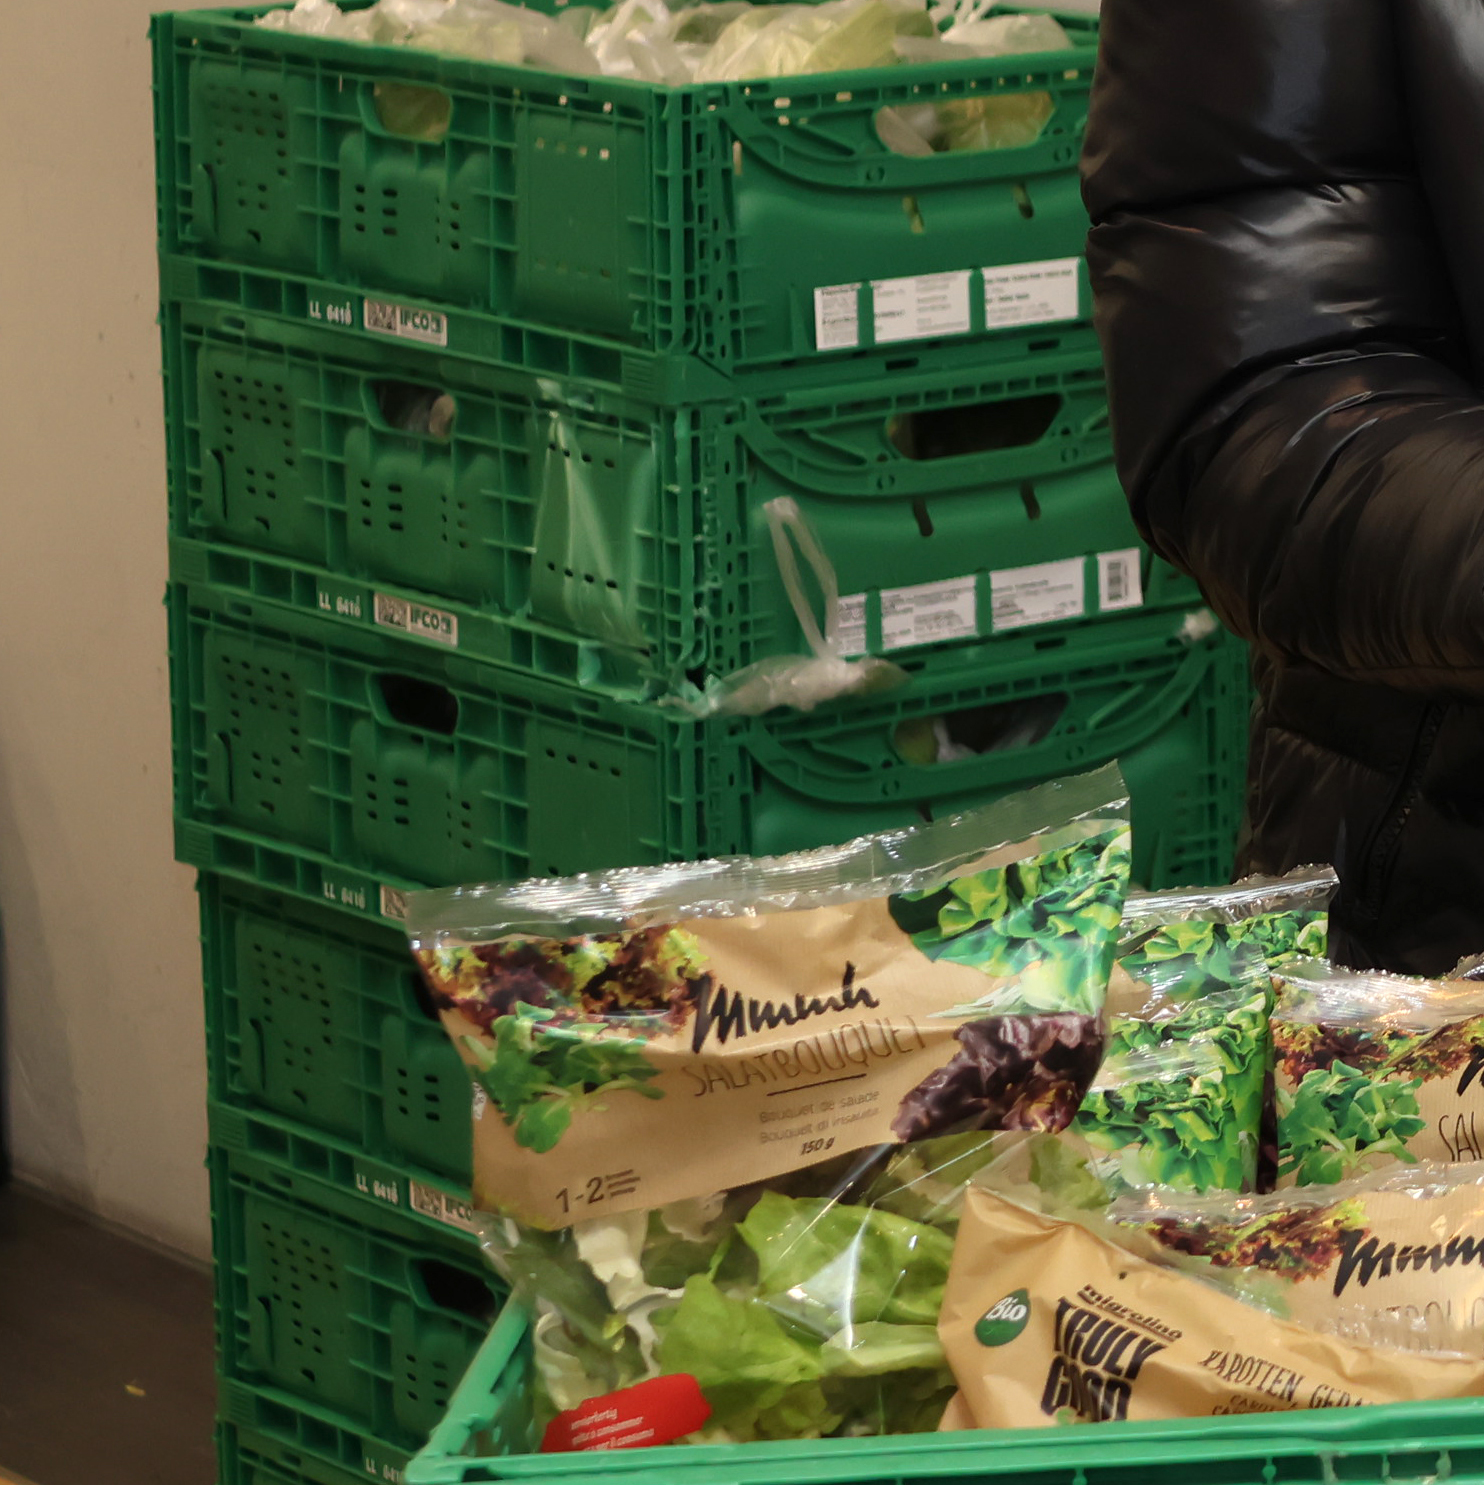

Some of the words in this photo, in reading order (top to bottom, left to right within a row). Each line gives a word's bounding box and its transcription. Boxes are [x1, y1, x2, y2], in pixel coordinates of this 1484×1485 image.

[682, 1016, 927, 1097] SALATBOUQUET
[801, 1138, 823, 1156] 150
[555, 1176, 605, 1213] 1-2
[983, 1296, 1028, 1322] Bio
[1054, 1296, 1168, 1381] TRULY
